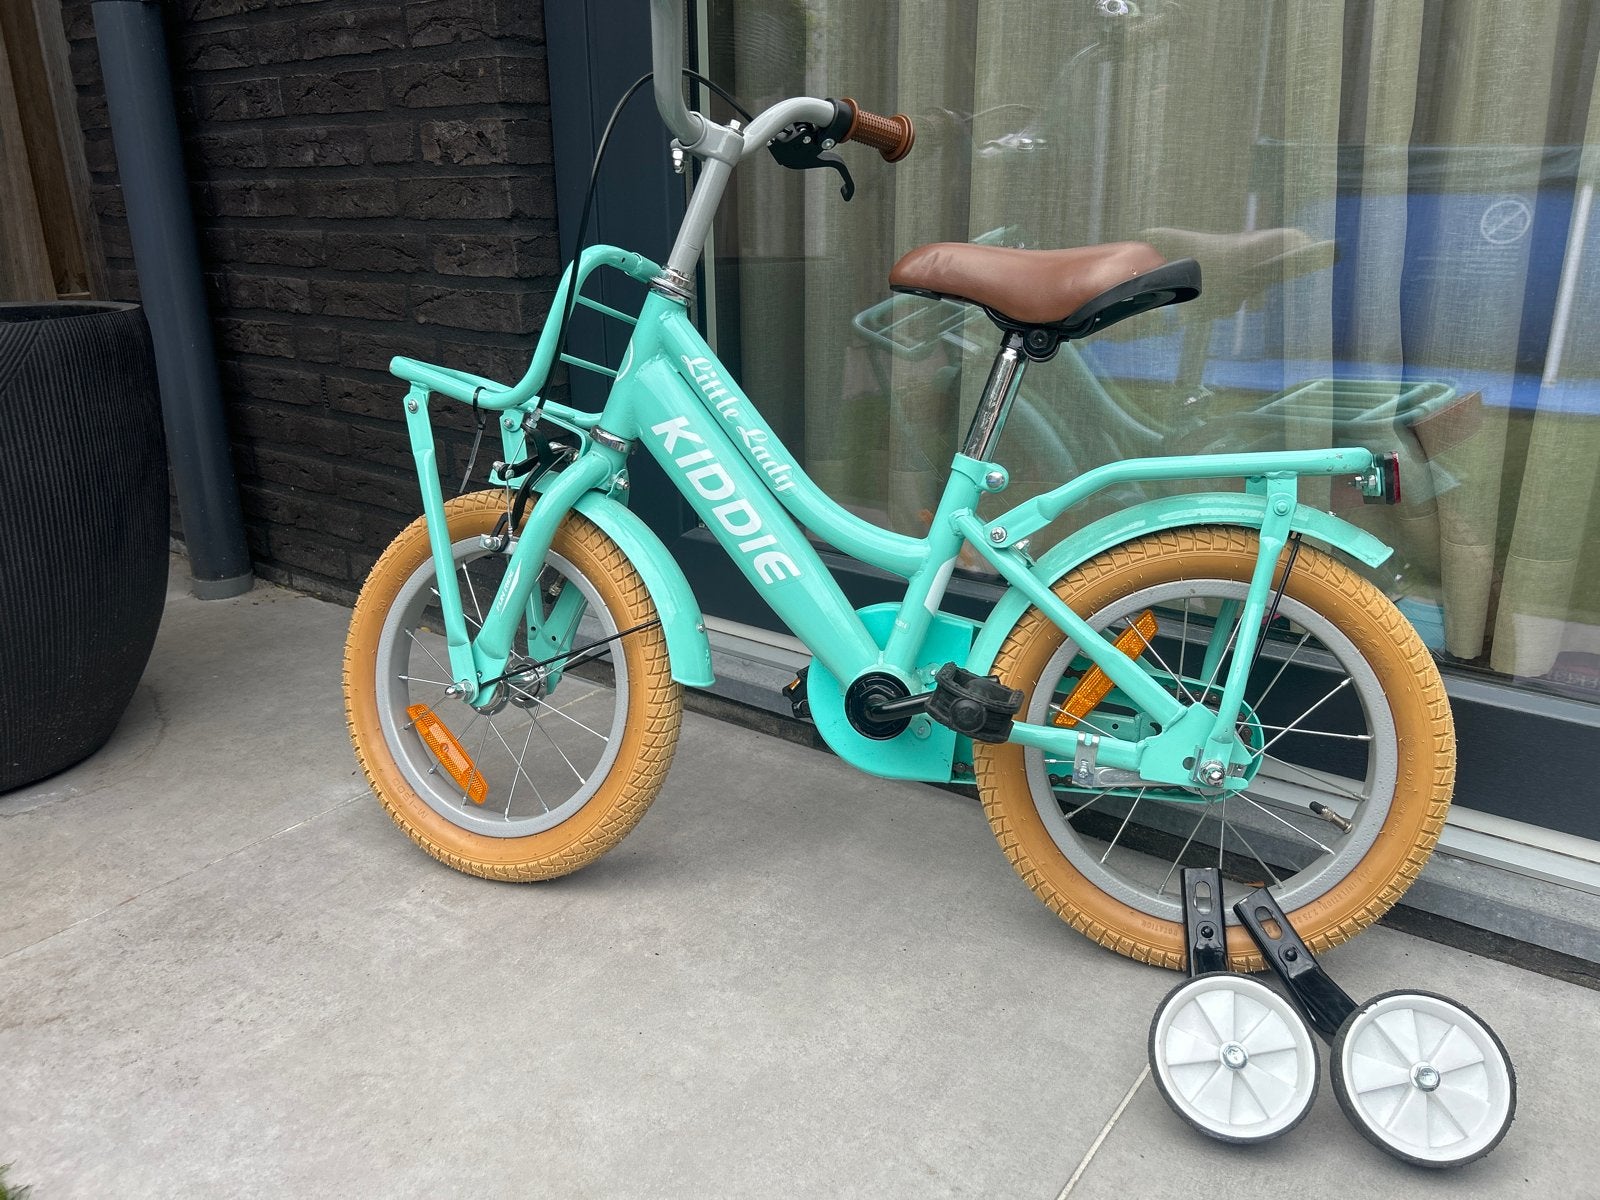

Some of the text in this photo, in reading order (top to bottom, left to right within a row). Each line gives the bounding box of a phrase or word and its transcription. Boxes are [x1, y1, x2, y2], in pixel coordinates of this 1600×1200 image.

[651, 415, 802, 585] KIDDIE
[681, 354, 797, 493] Little Lady
